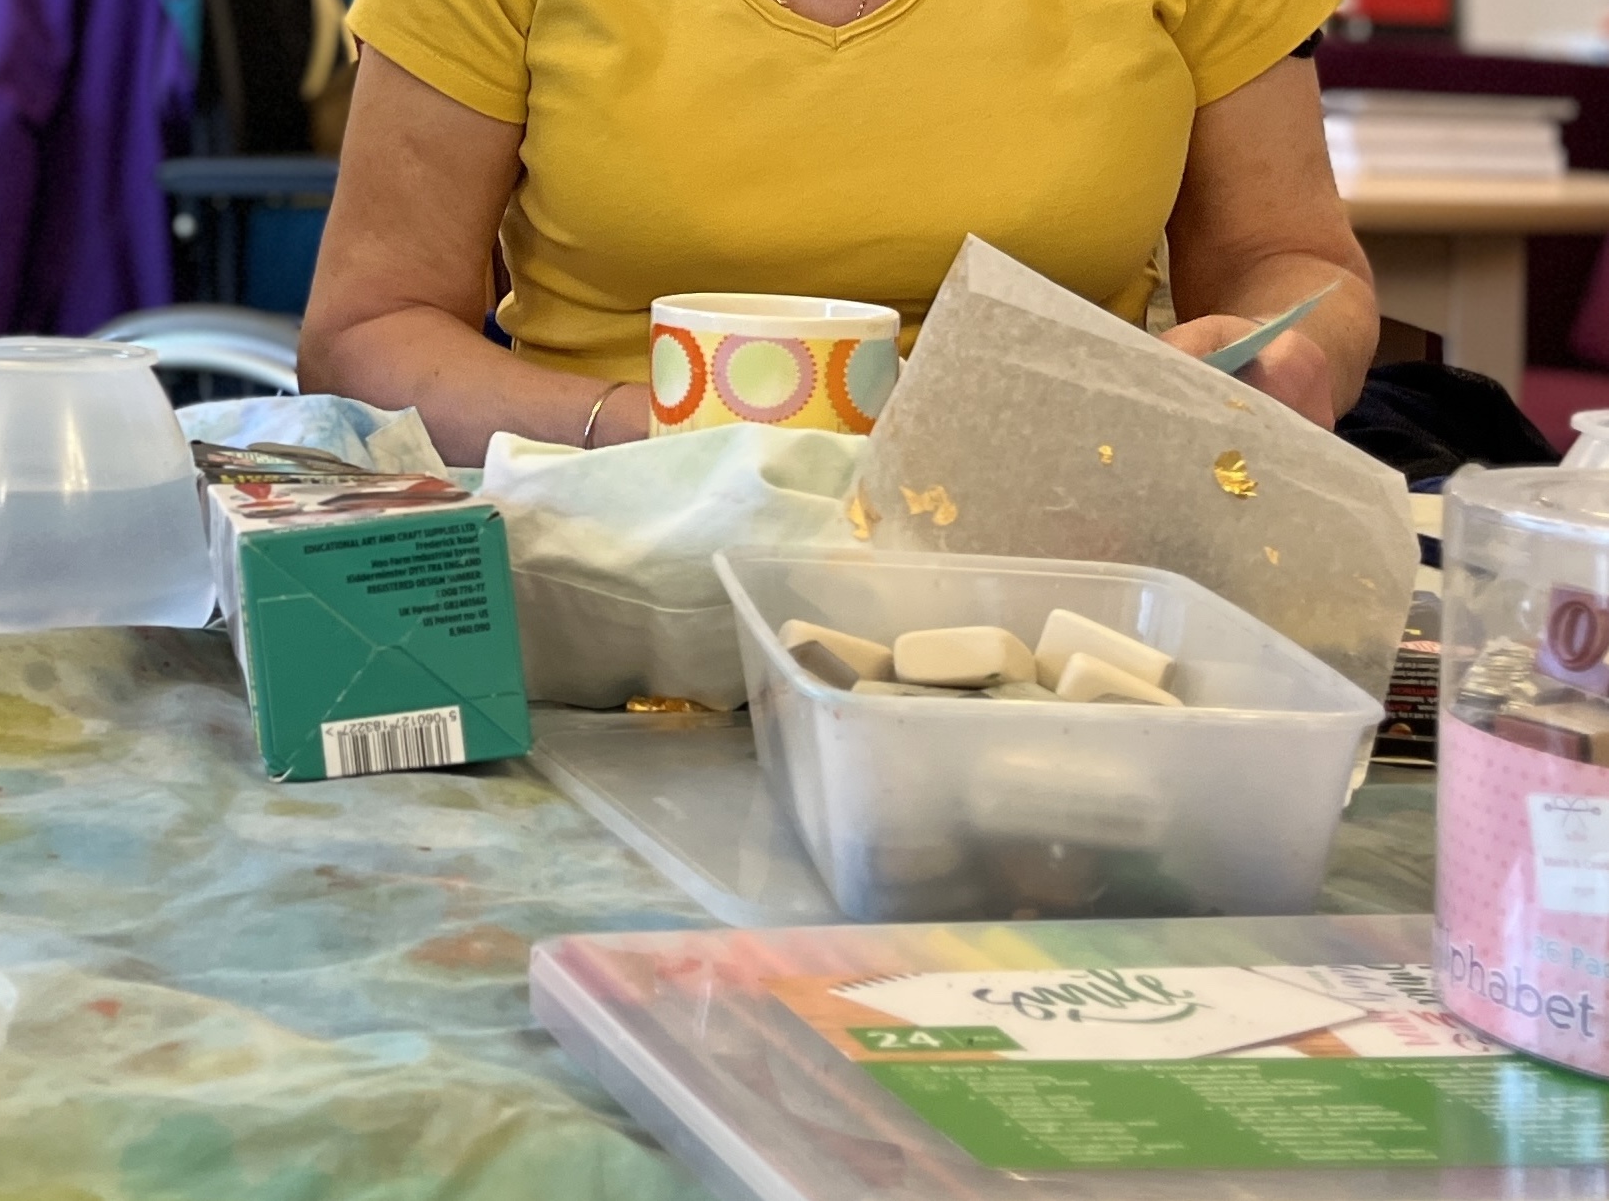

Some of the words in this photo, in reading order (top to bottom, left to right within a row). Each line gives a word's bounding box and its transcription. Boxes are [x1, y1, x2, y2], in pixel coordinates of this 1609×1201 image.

[361, 535, 378, 547] ART
[379, 533, 396, 545] AND
[866, 1030, 941, 1048] 24
